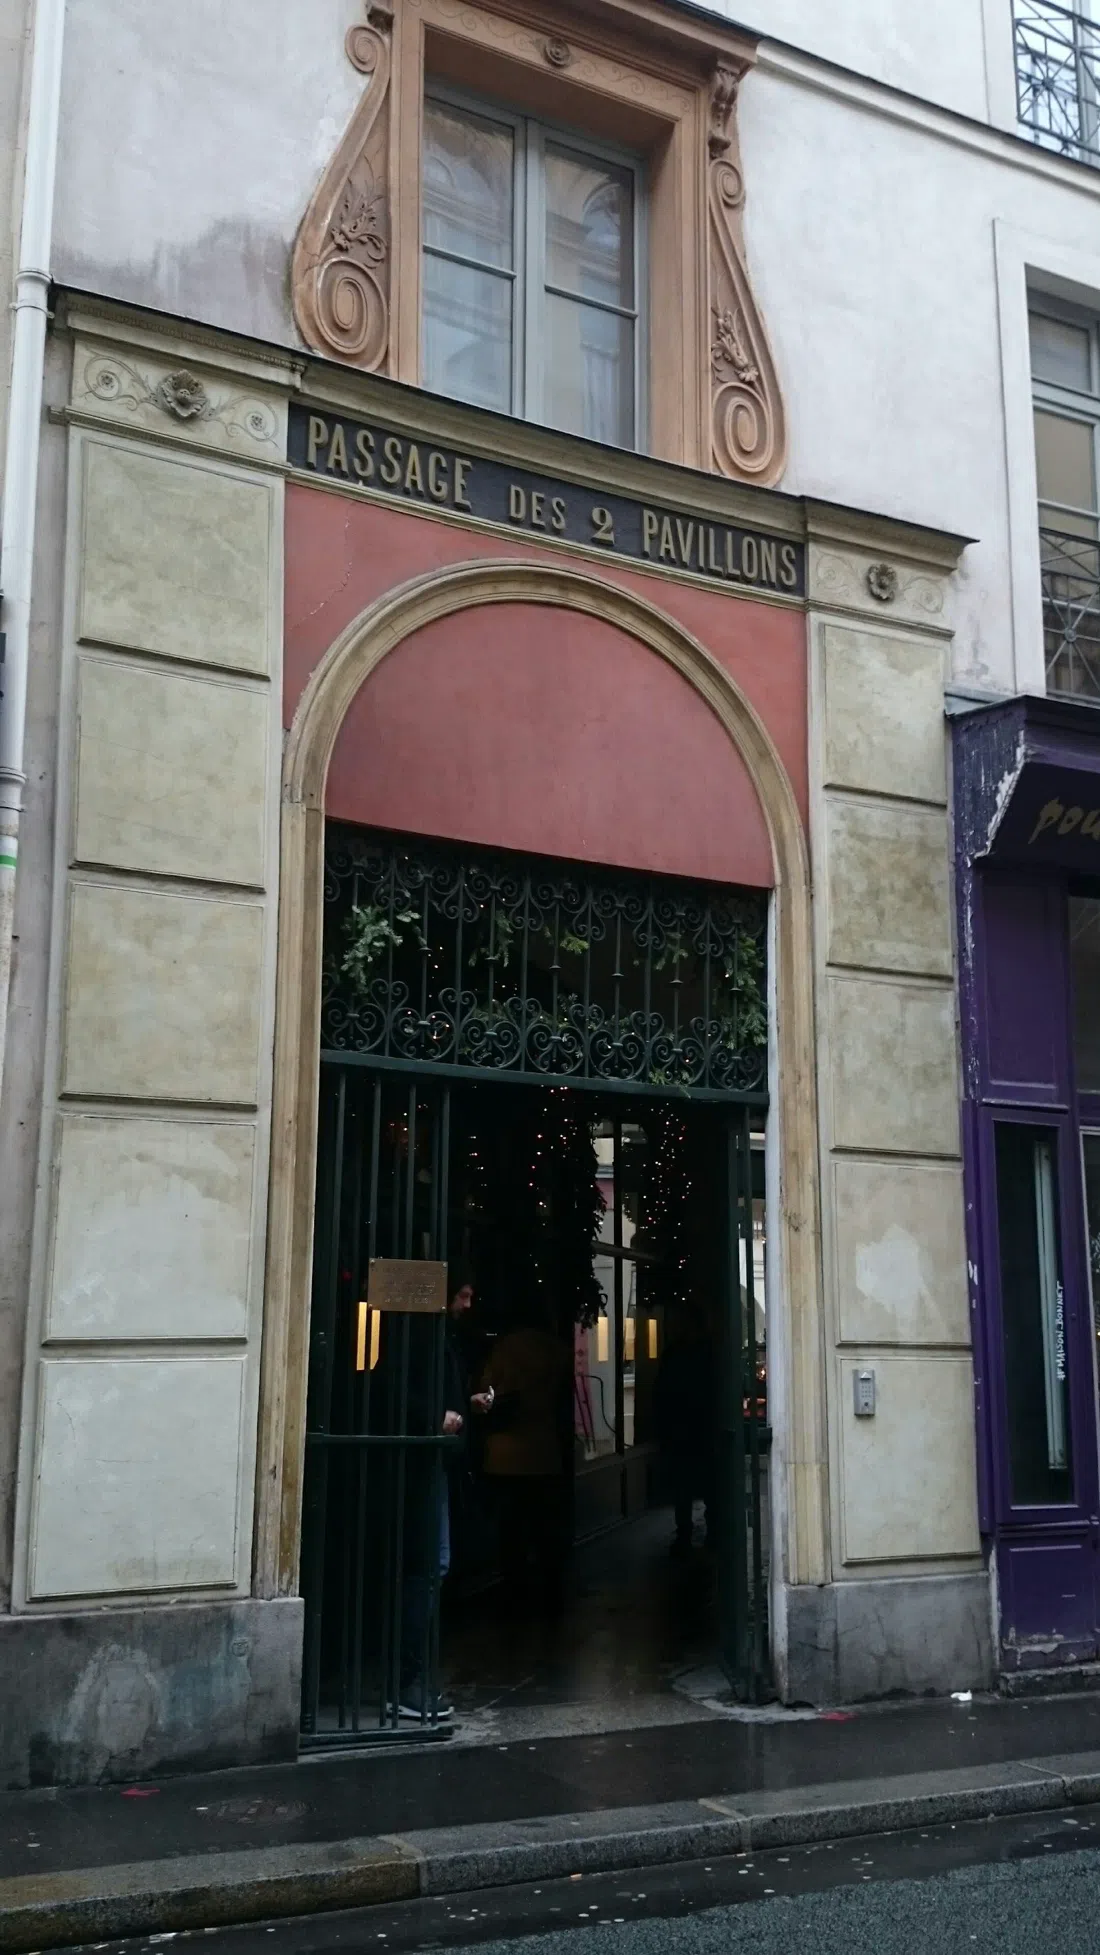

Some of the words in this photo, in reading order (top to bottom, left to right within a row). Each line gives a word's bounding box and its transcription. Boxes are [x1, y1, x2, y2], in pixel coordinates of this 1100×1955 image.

[307, 415, 473, 510] PASSAGE
[509, 484, 568, 531] DES
[591, 506, 616, 545] 2
[642, 509, 798, 587] PAVILLONS
